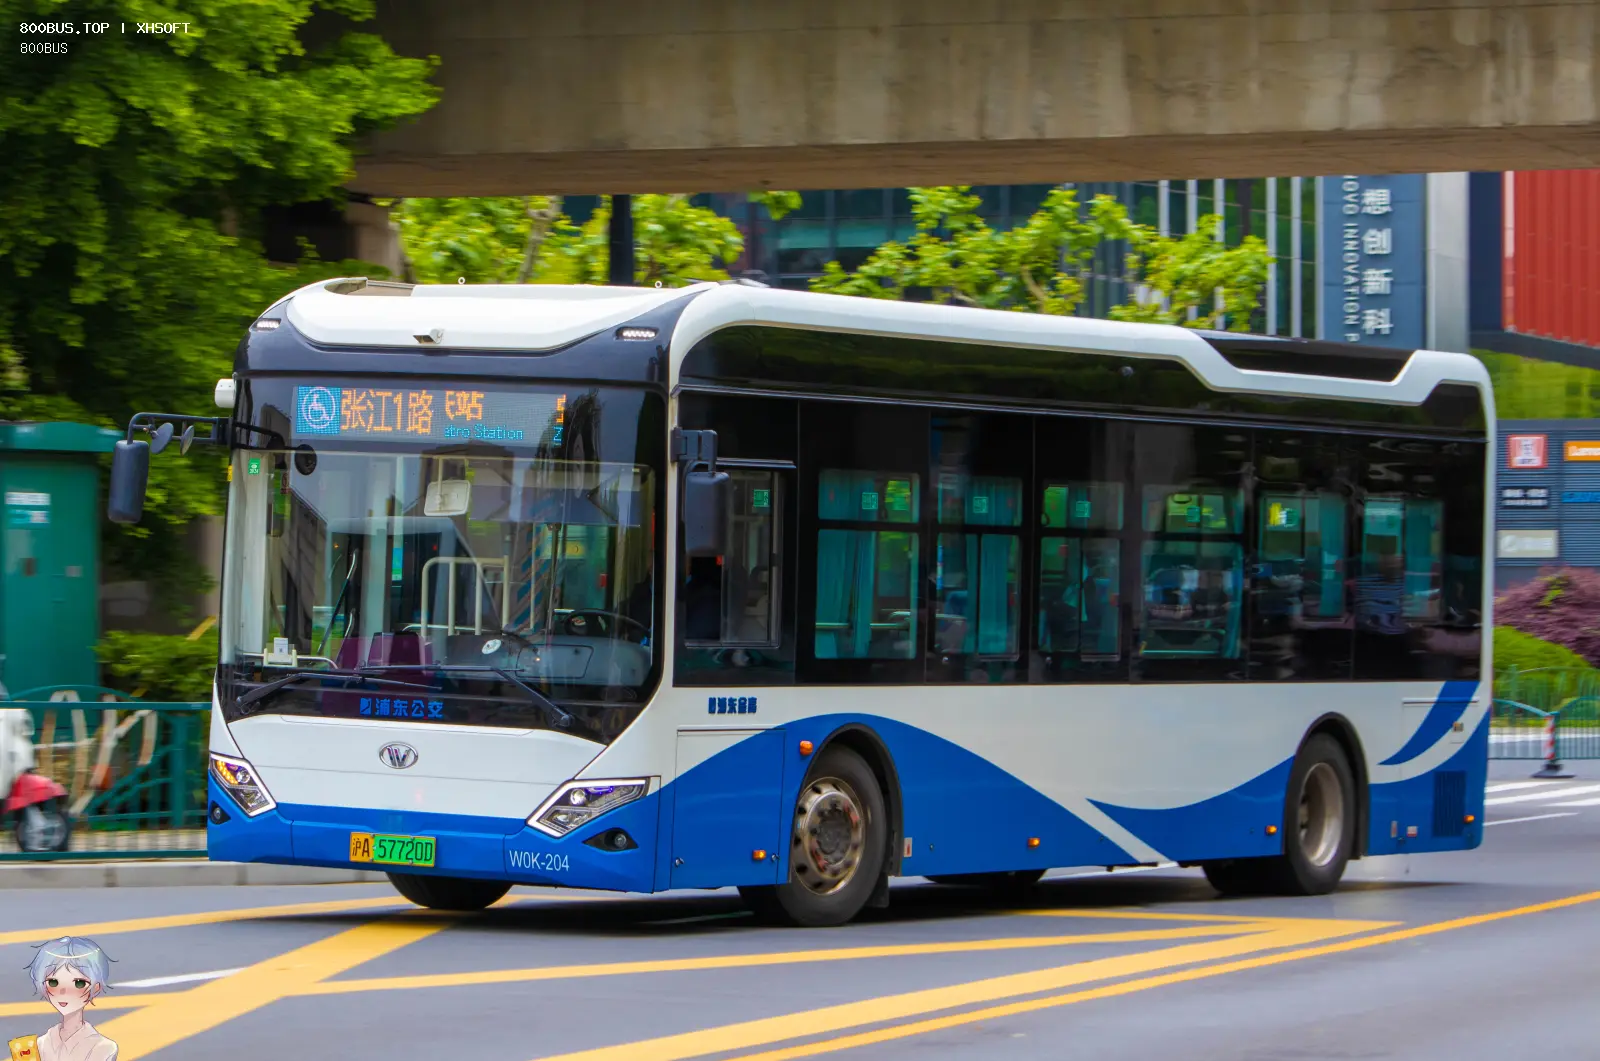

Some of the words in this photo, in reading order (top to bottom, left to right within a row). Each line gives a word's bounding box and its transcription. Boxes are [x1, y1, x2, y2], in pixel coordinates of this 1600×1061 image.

[1343, 223, 1360, 325] INNOVATION
[340, 388, 433, 435] 张江1路
[474, 423, 524, 440] Station
[375, 698, 444, 718] 浦东公交
